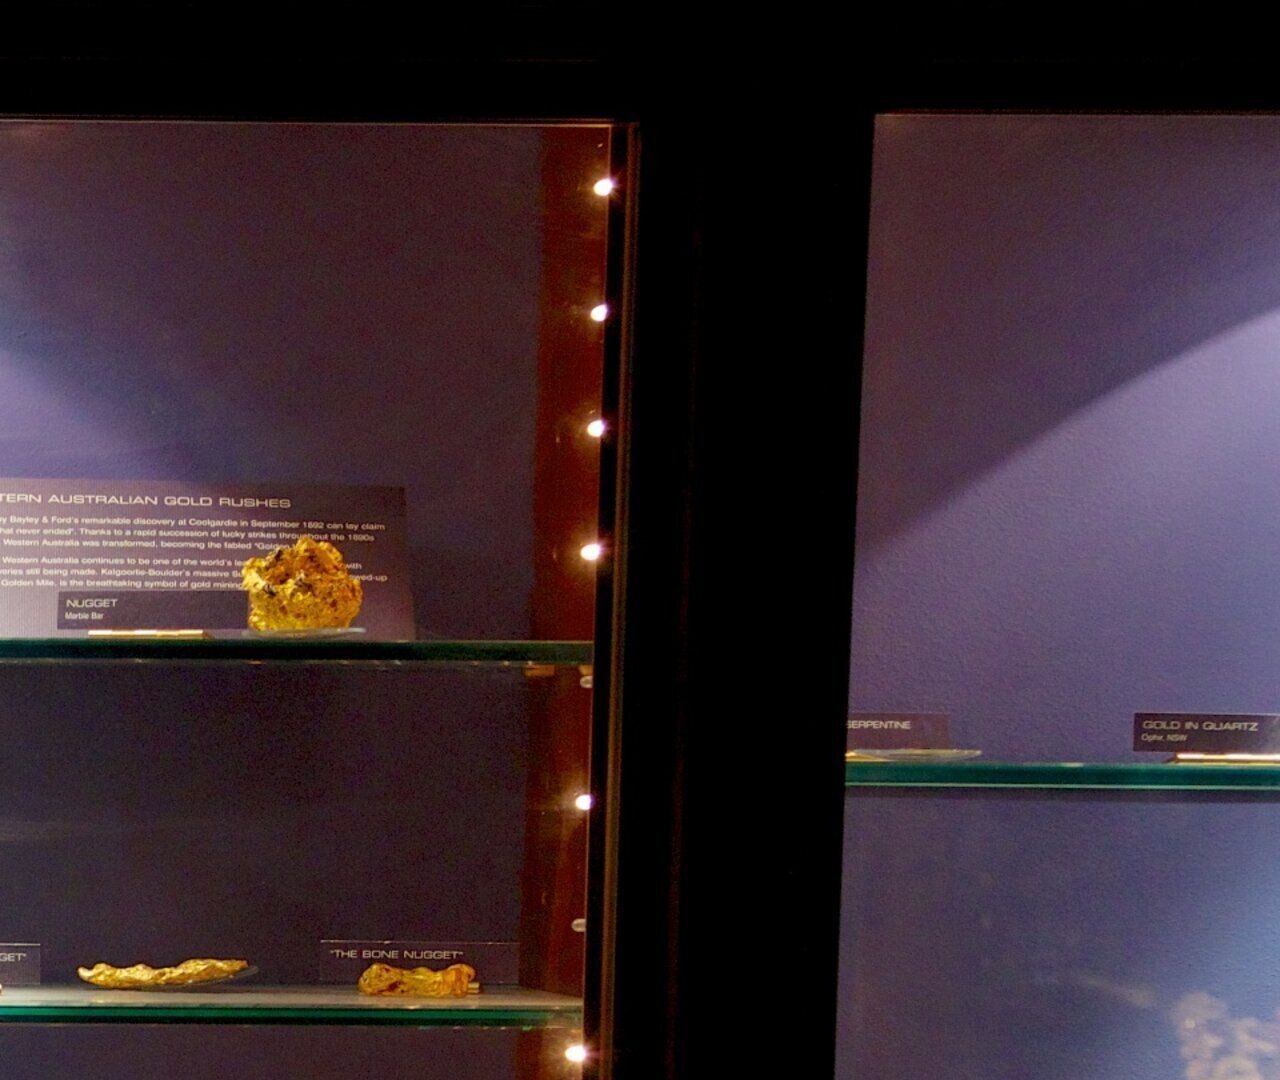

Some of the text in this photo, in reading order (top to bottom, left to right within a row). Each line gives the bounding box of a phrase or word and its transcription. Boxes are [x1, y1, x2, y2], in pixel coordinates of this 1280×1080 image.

[47, 494, 159, 505] AUSTRALIAN
[163, 496, 213, 506] GOLD
[218, 497, 291, 507] RUSHES
[65, 598, 118, 608] NUGGET
[1141, 721, 1259, 731] GOLD IN QUARTZ
[361, 950, 399, 959] BONE
